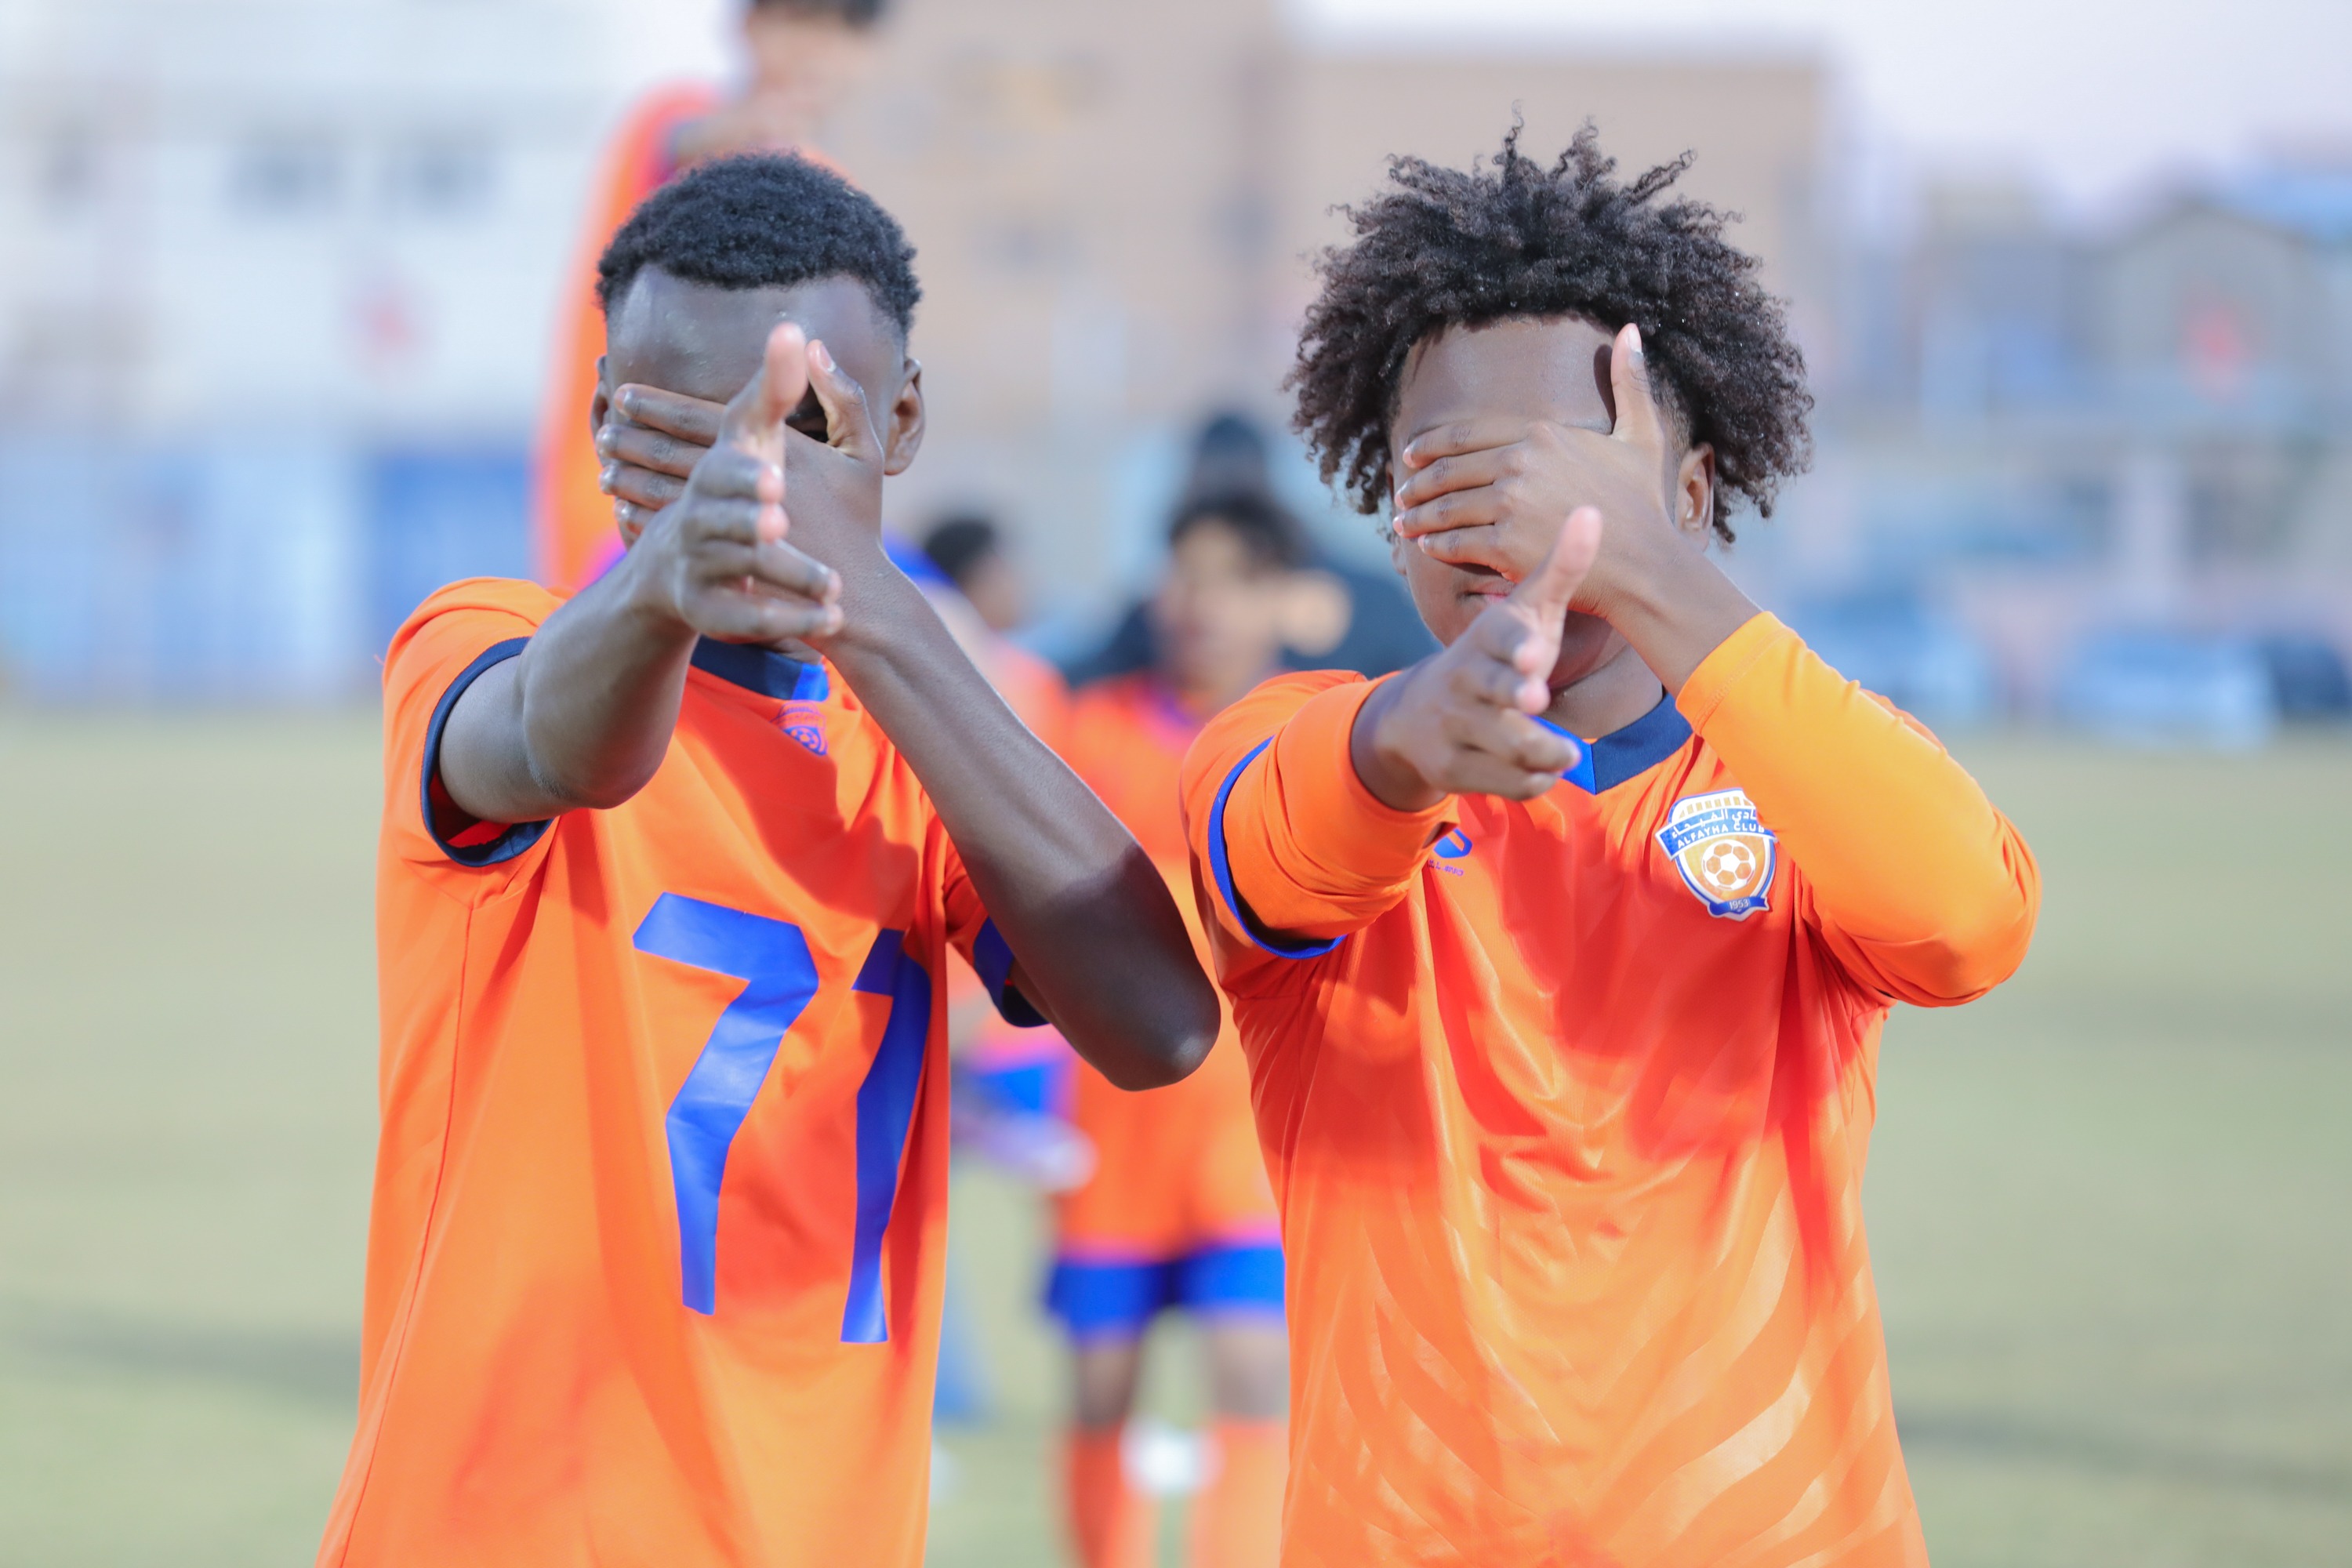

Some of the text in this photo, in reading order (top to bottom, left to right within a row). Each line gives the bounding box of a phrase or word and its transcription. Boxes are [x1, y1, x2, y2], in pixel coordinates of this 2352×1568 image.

[1678, 823, 1729, 849] ALFAYHA
[1729, 898, 1749, 910] 1953
[632, 891, 931, 1344] 77
